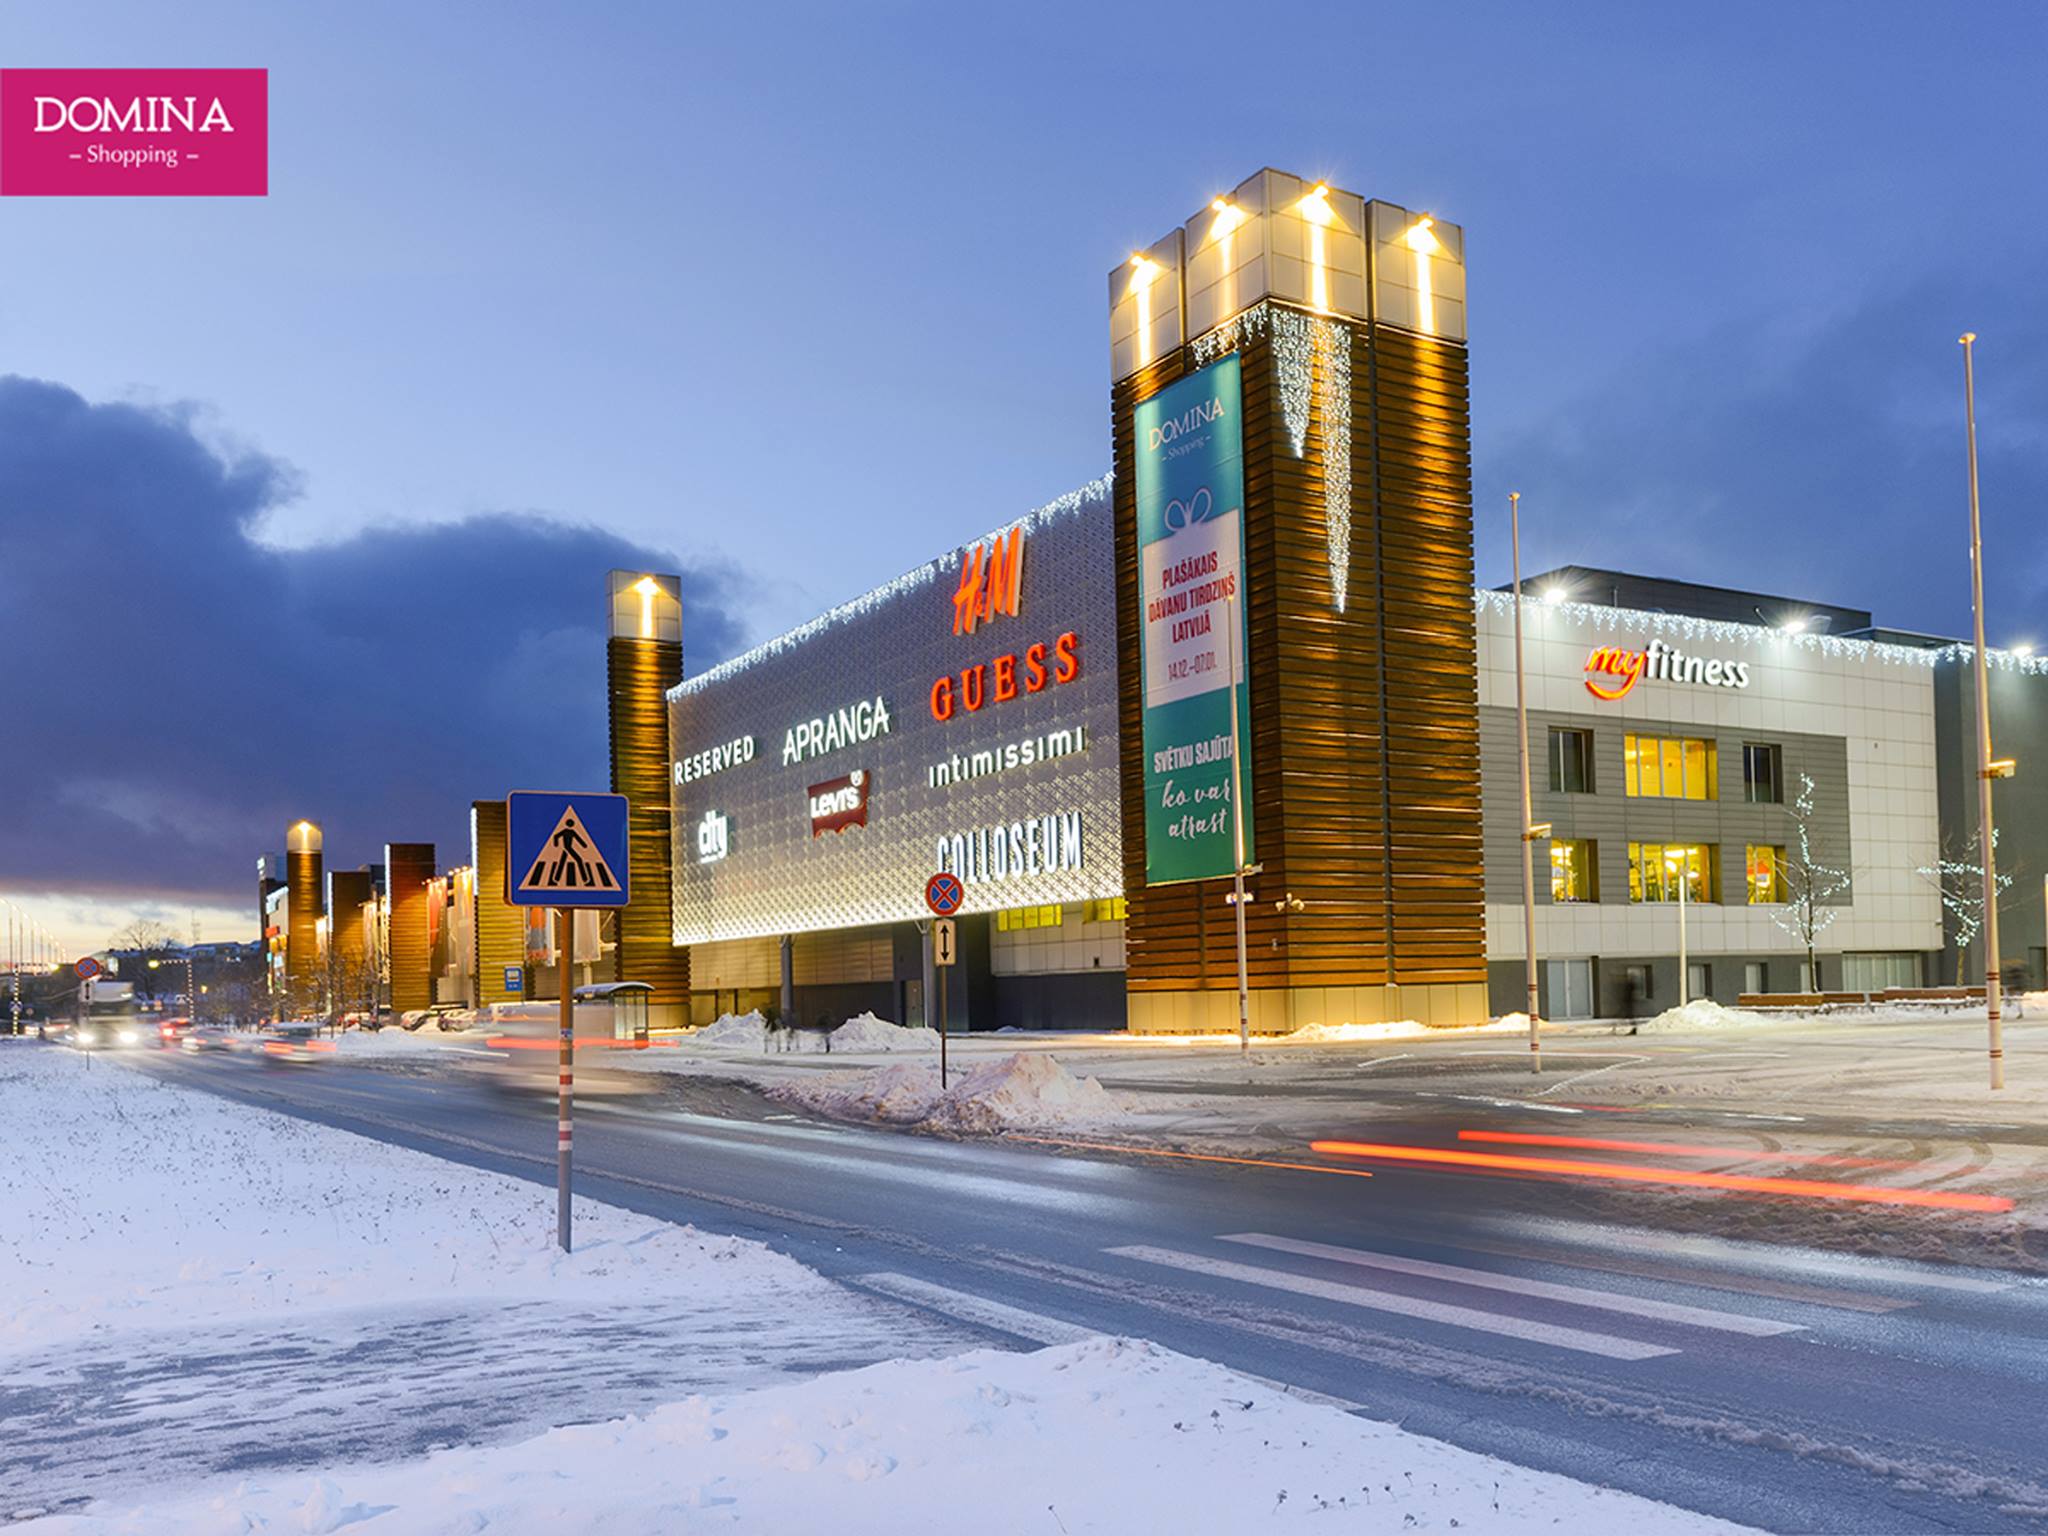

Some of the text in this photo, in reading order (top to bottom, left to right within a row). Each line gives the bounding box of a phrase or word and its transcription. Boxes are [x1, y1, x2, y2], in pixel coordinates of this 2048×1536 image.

[1149, 397, 1225, 452] DOMINA
[952, 526, 1025, 636] H&M
[930, 631, 1078, 721] GUESS
[1584, 638, 1750, 701] myfitness
[674, 735, 755, 785] RESERVED
[783, 696, 890, 766] APRANGA
[929, 726, 1086, 788] intimissimi
[1154, 745, 1194, 773] SVĒTKU
[1162, 778, 1232, 809] ko var
[1168, 808, 1228, 841] atrast
[937, 811, 1082, 884] COLLOSEUM
